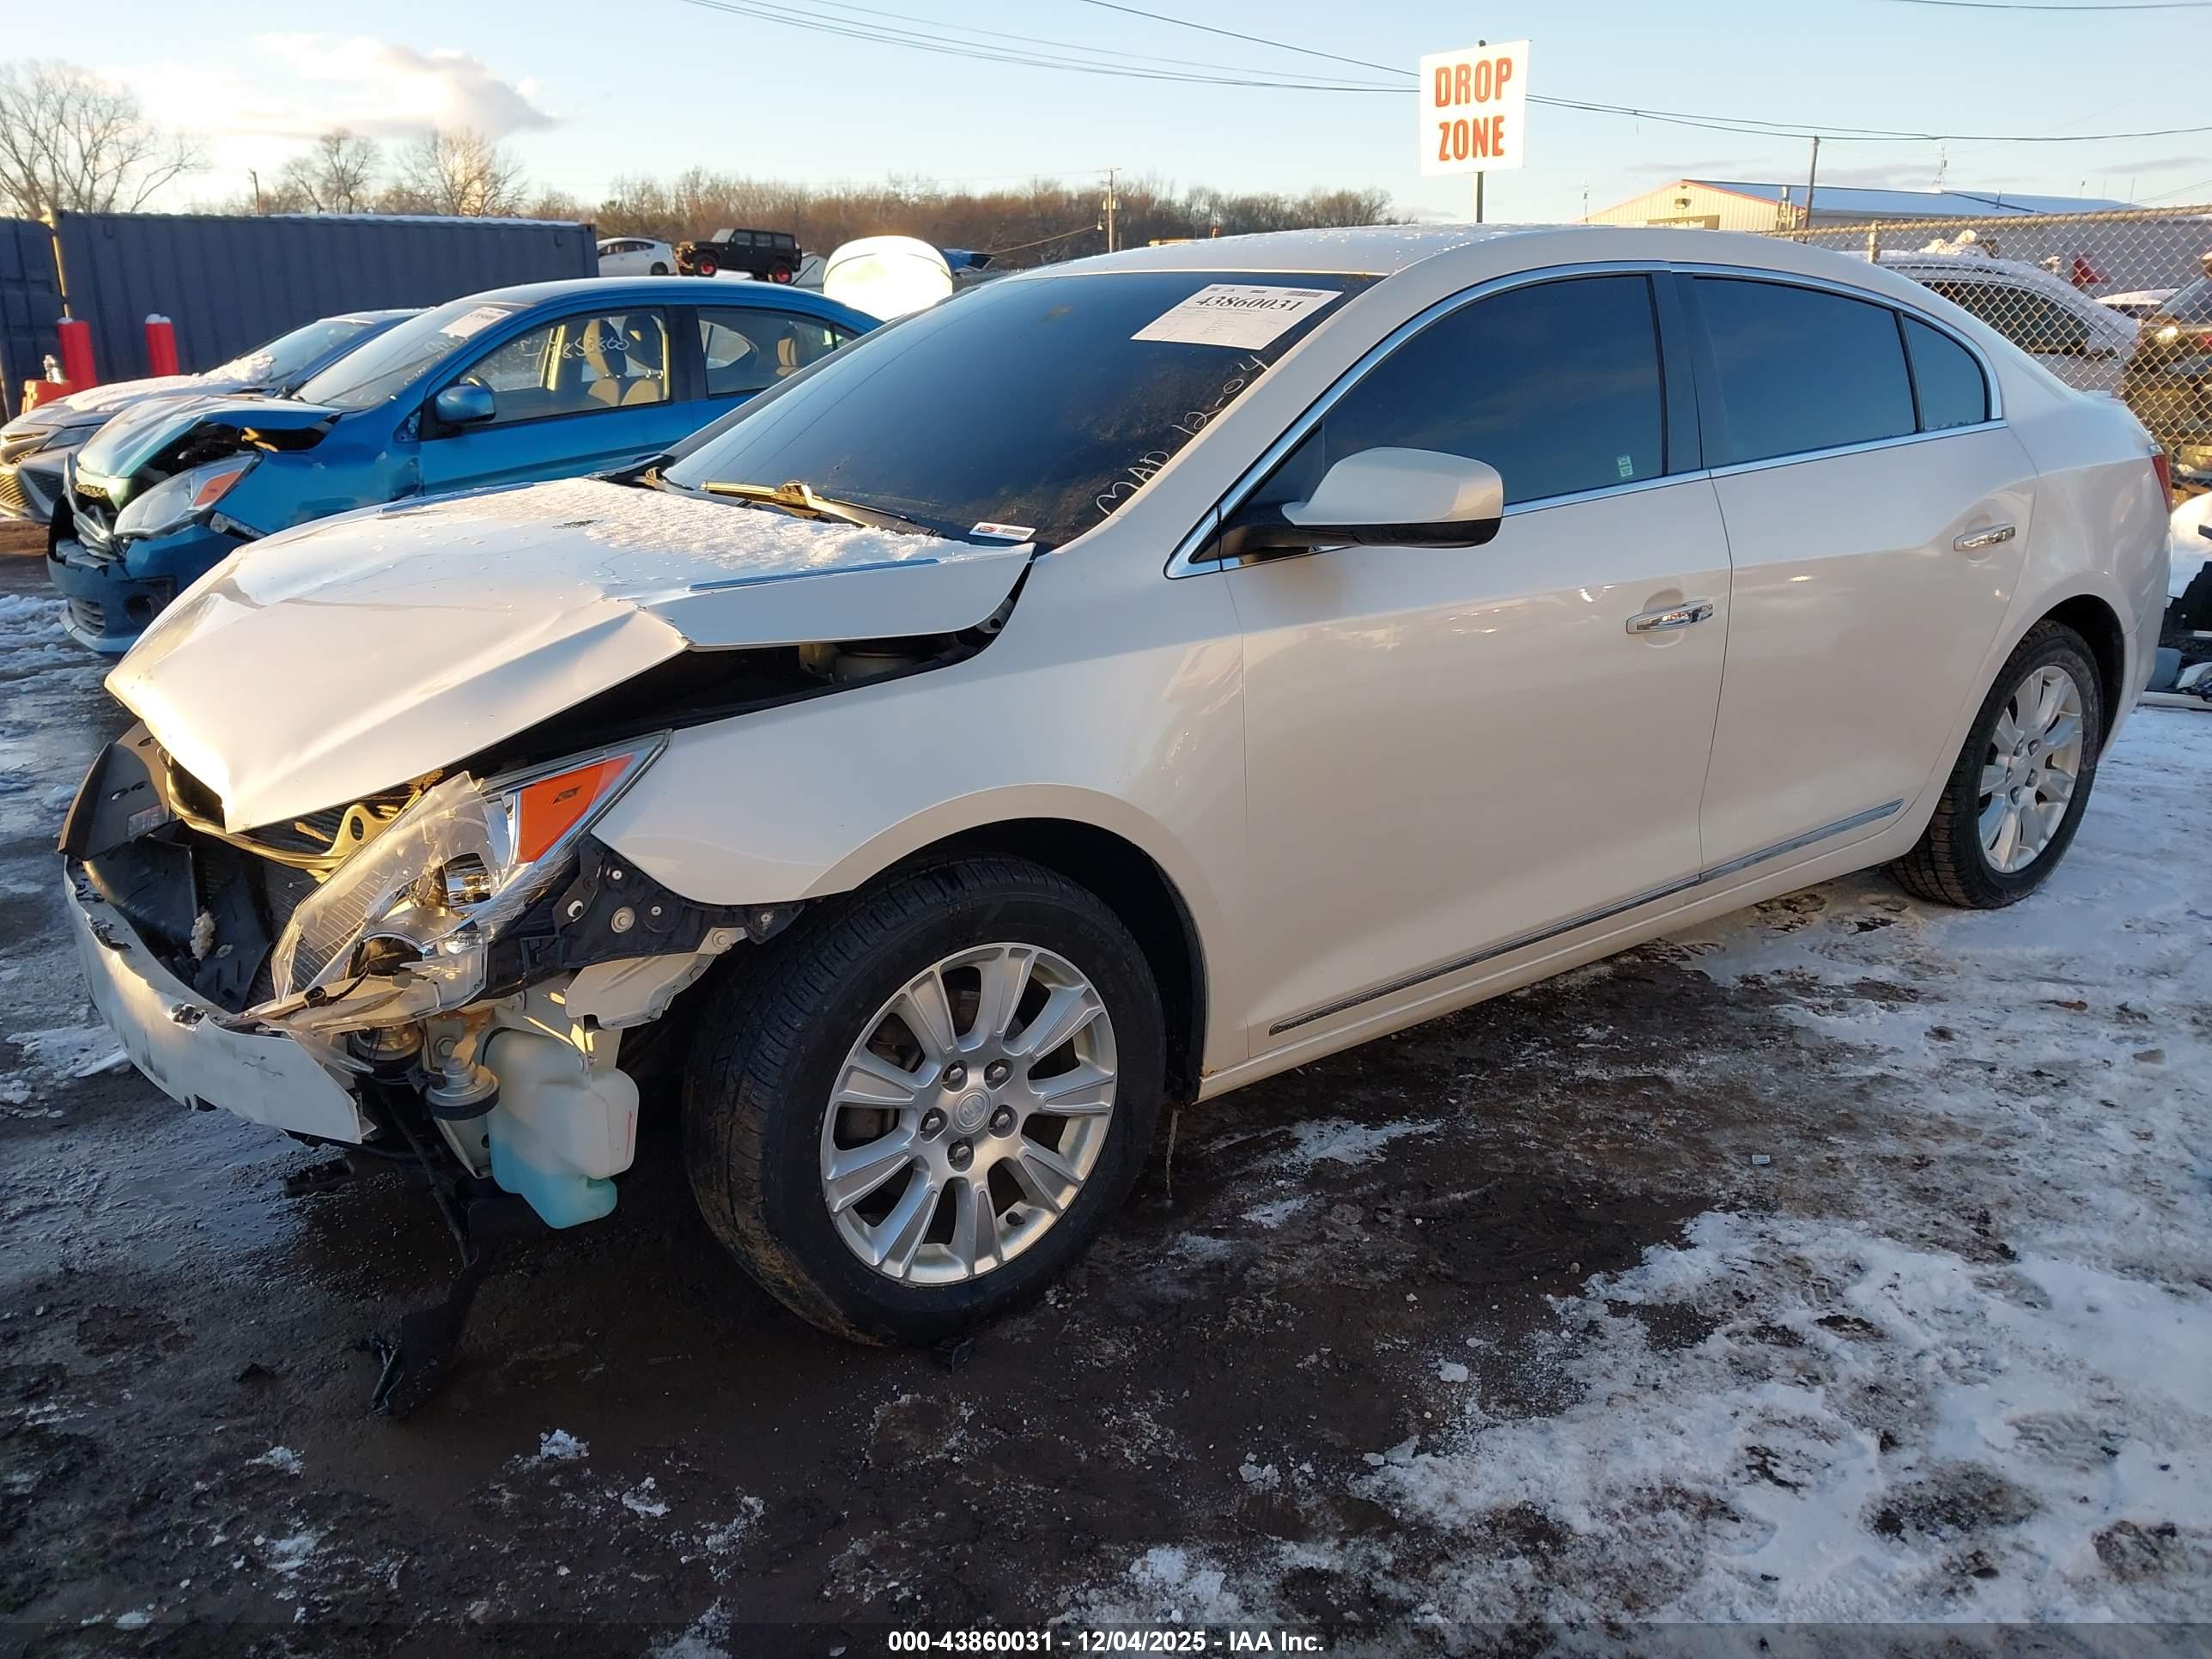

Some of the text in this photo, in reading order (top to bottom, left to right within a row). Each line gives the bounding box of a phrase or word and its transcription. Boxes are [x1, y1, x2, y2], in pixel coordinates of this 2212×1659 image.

[1435, 57, 1512, 107] DROP
[1438, 115, 1505, 161] ZONE
[1195, 295, 1304, 311] 43860031
[1170, 355, 1270, 436] 12-04
